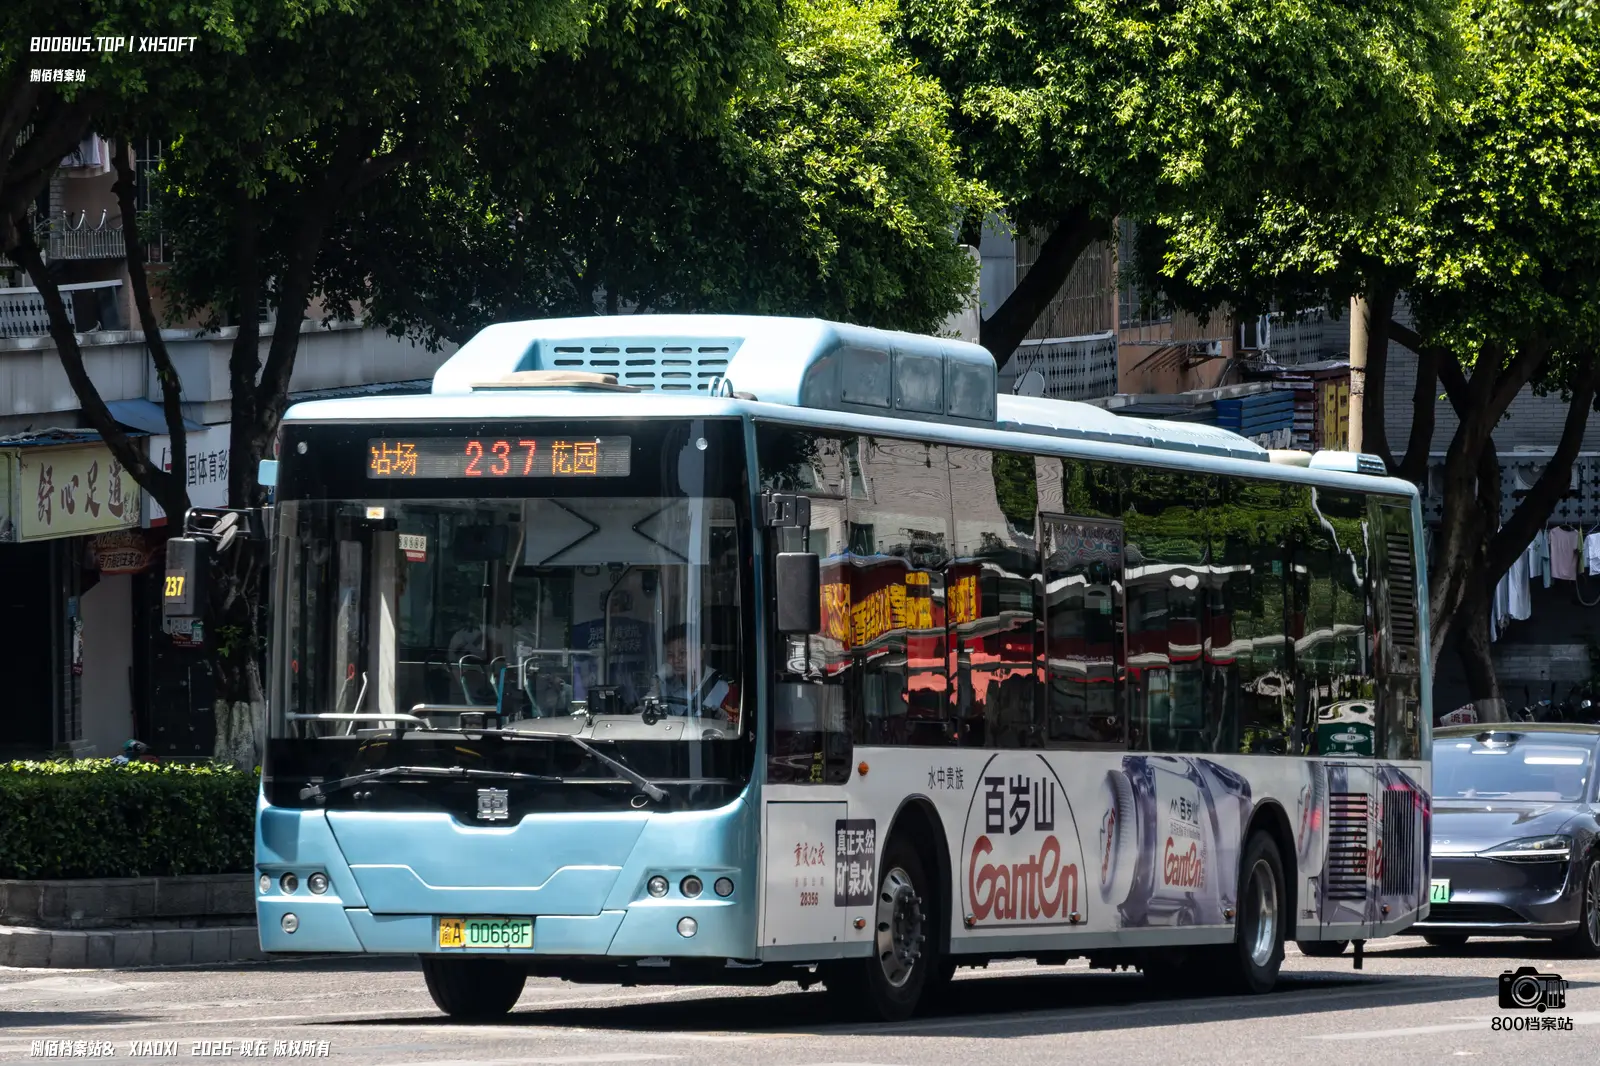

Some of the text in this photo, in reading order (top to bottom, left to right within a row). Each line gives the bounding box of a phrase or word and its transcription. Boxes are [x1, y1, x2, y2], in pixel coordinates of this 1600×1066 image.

[464, 440, 536, 476] 237
[551, 440, 597, 475] 花园
[165, 576, 185, 597] 237
[928, 766, 964, 790] 水中贵族
[984, 774, 1054, 836] 百岁山
[837, 828, 875, 856] 真正天然
[836, 861, 873, 896] 矿泉水
[969, 834, 1079, 921] Ganten
[1431, 884, 1446, 900] 71
